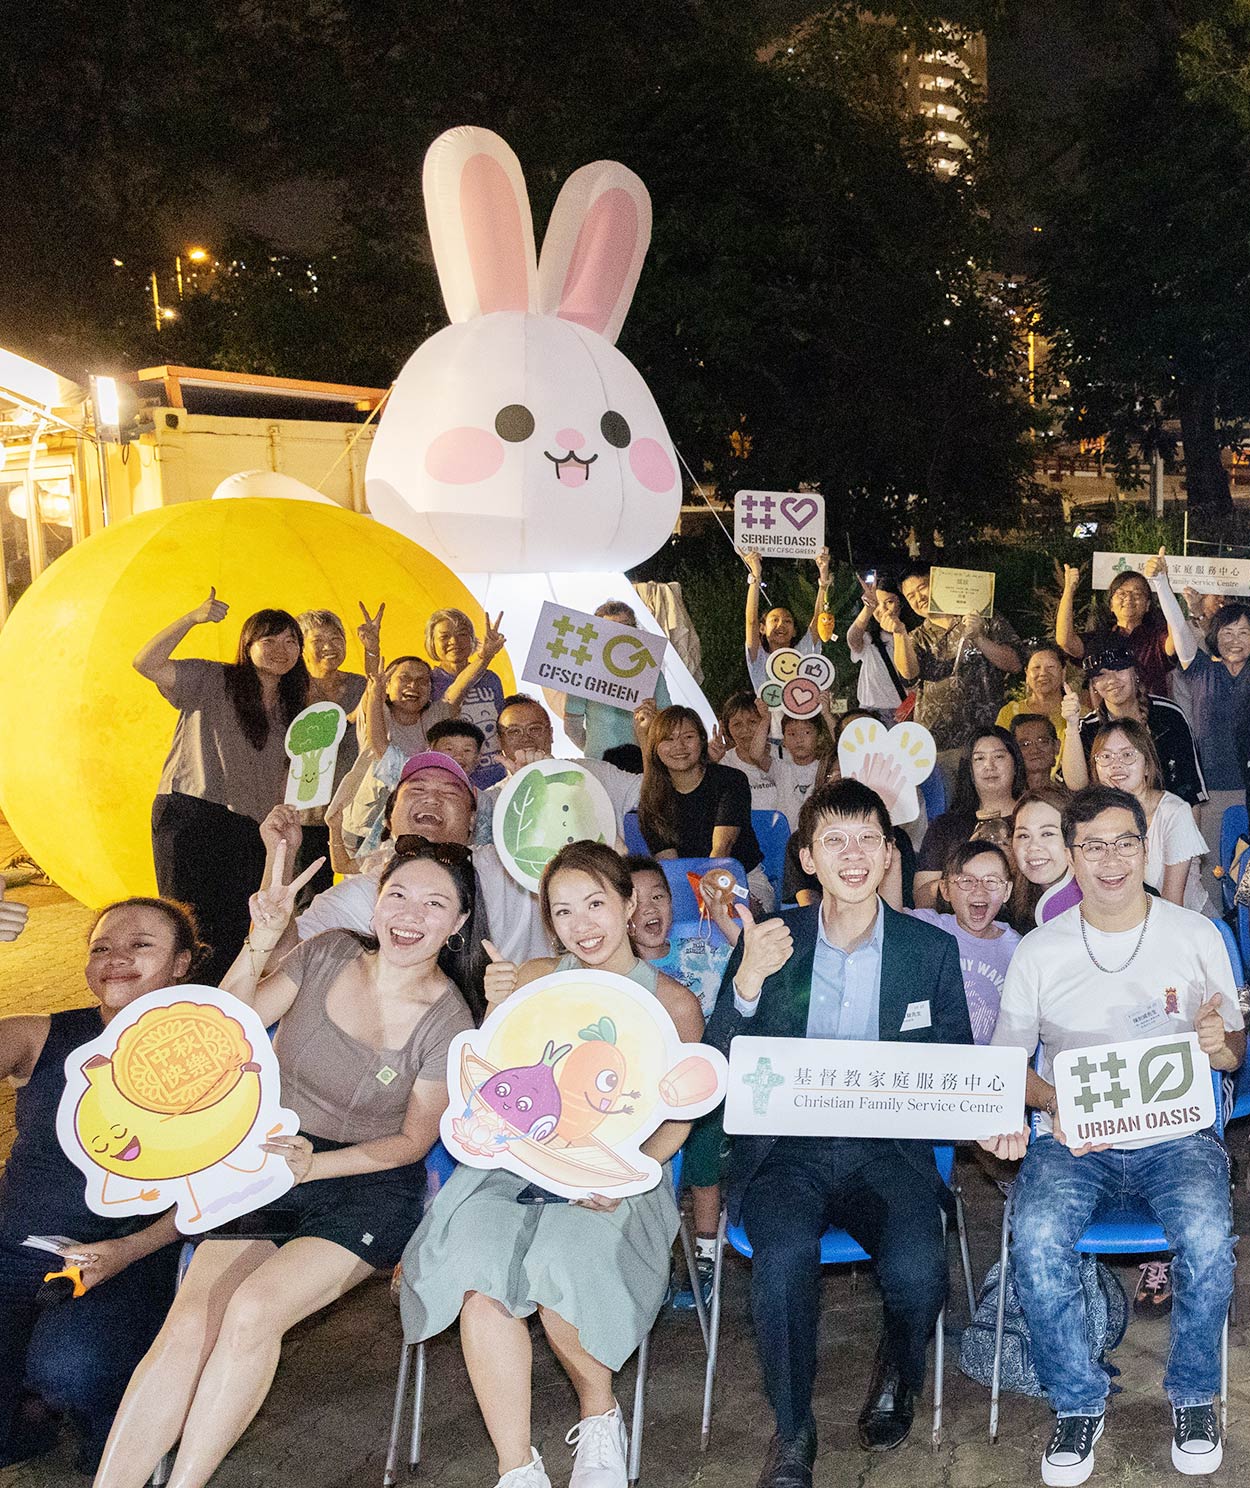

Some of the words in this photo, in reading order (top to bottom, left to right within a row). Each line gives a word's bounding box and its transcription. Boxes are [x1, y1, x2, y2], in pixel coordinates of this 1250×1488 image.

[741, 533, 783, 545] SERENE
[784, 536, 817, 547] OASIS
[1217, 579, 1239, 588] Centre
[538, 663, 583, 688] CFSC
[584, 675, 640, 704] GREEN
[793, 1067, 1005, 1092] 基督教家庭服務中心
[794, 1094, 854, 1109] Christian
[859, 1097, 903, 1113] Family
[907, 1098, 956, 1112] Service
[959, 1099, 1004, 1114] Centre
[1077, 1115, 1141, 1140] URBAN
[1145, 1106, 1201, 1130] OASIS
